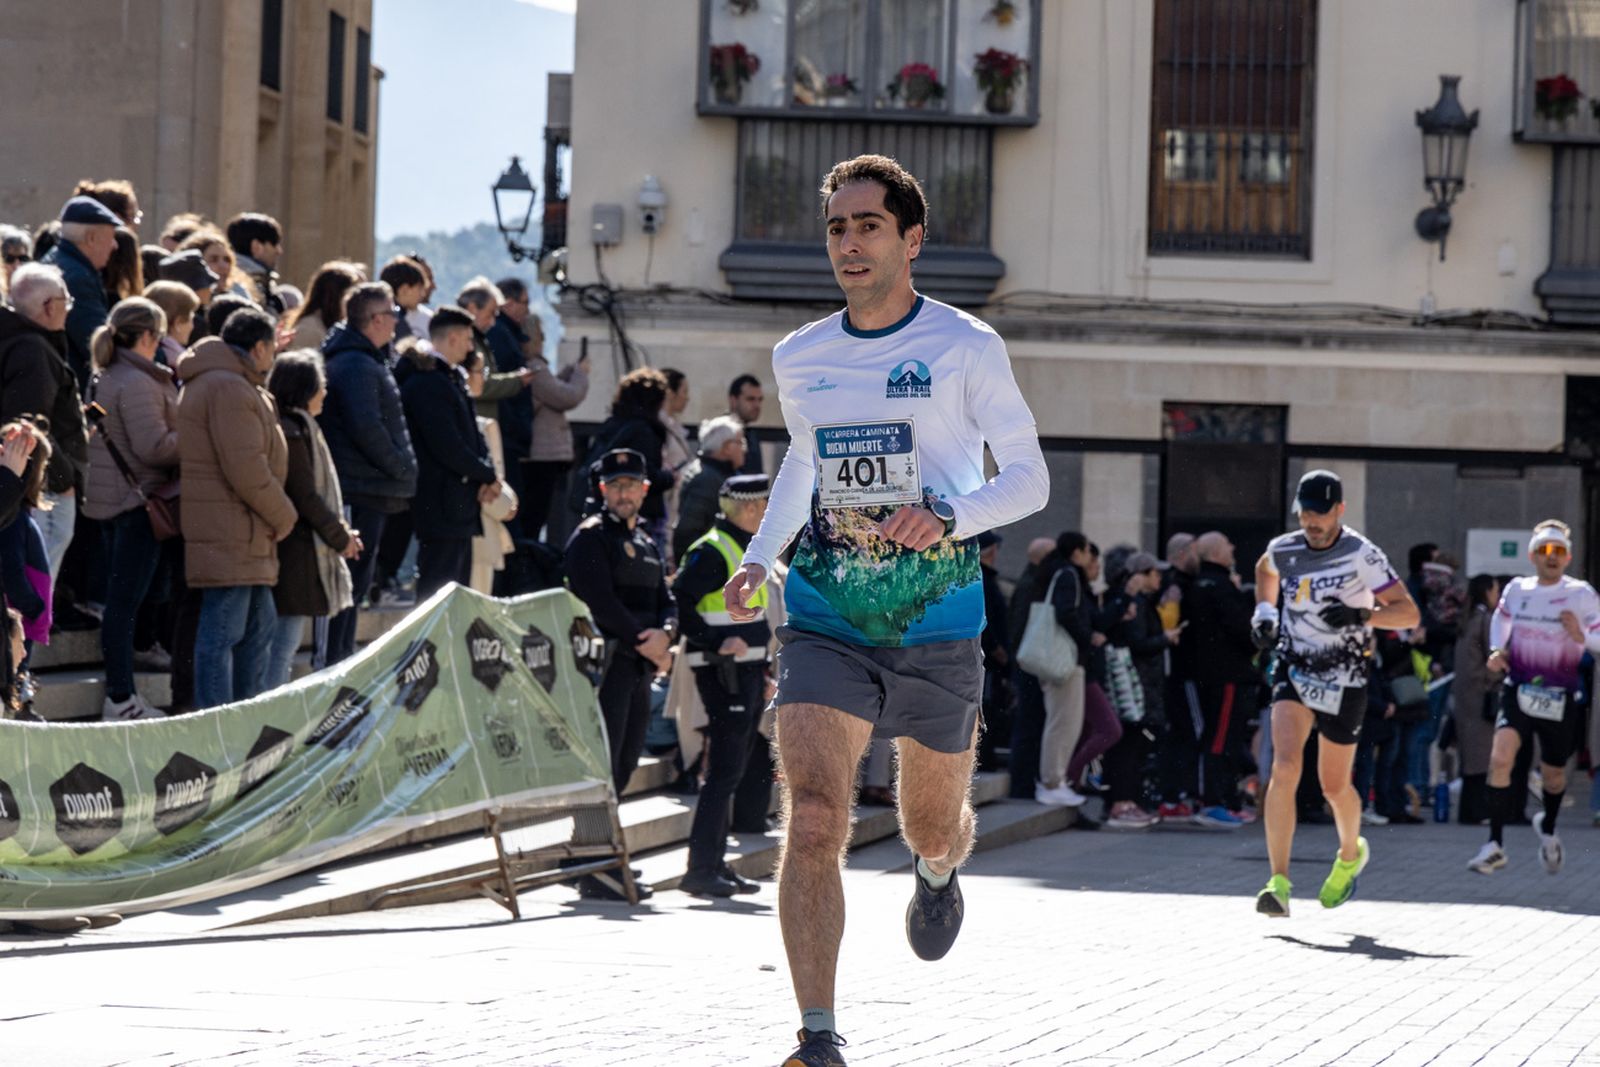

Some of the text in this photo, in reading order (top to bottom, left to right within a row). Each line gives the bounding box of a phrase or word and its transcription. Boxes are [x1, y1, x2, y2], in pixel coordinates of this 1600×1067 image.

[830, 429, 860, 439] CARRERA
[861, 426, 900, 437] CAMINATA
[825, 439, 883, 455] BUENA MUERTE
[837, 456, 888, 488] 401
[1299, 681, 1325, 701] 261
[164, 771, 209, 808] ownat
[62, 786, 113, 820] ownat
